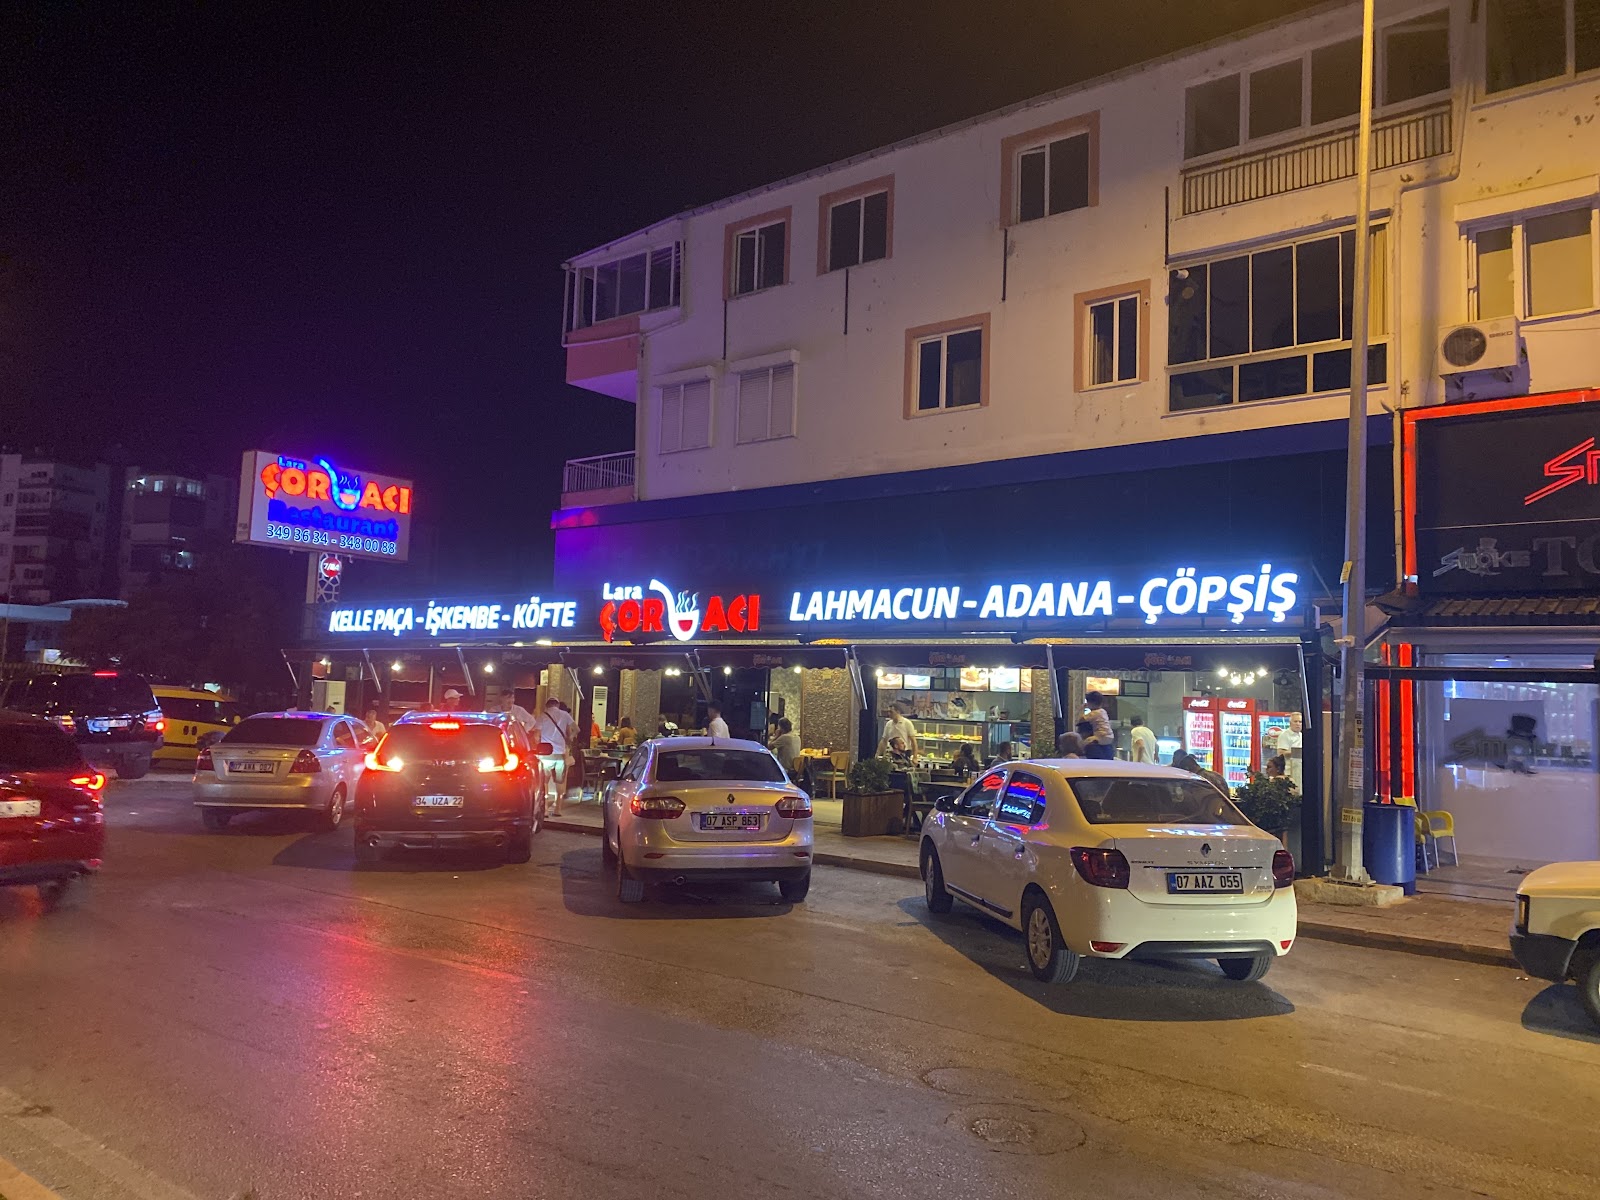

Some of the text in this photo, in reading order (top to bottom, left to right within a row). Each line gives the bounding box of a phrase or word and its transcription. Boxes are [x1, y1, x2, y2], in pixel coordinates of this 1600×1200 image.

[278, 456, 305, 470] Lara
[267, 524, 291, 540] 349
[294, 528, 310, 542] 36
[313, 531, 328, 545] 34
[339, 535, 361, 550] 348
[364, 538, 379, 552] 00
[381, 541, 396, 555] 88
[603, 582, 643, 600] Lara
[789, 587, 960, 621] LAHMACUN
[979, 580, 1113, 618] ADANA
[1140, 564, 1298, 624] ÇÖPŞİŞ
[329, 610, 373, 633] KELLE
[373, 608, 413, 636] PAÇA
[425, 600, 501, 636] İŞKEMBE
[512, 596, 576, 628] KÖFTE
[416, 797, 427, 806] 34
[432, 797, 449, 806] UZA
[707, 816, 717, 825] 07
[722, 816, 737, 825] ASP
[1176, 875, 1240, 888] 07 AAZ 055
